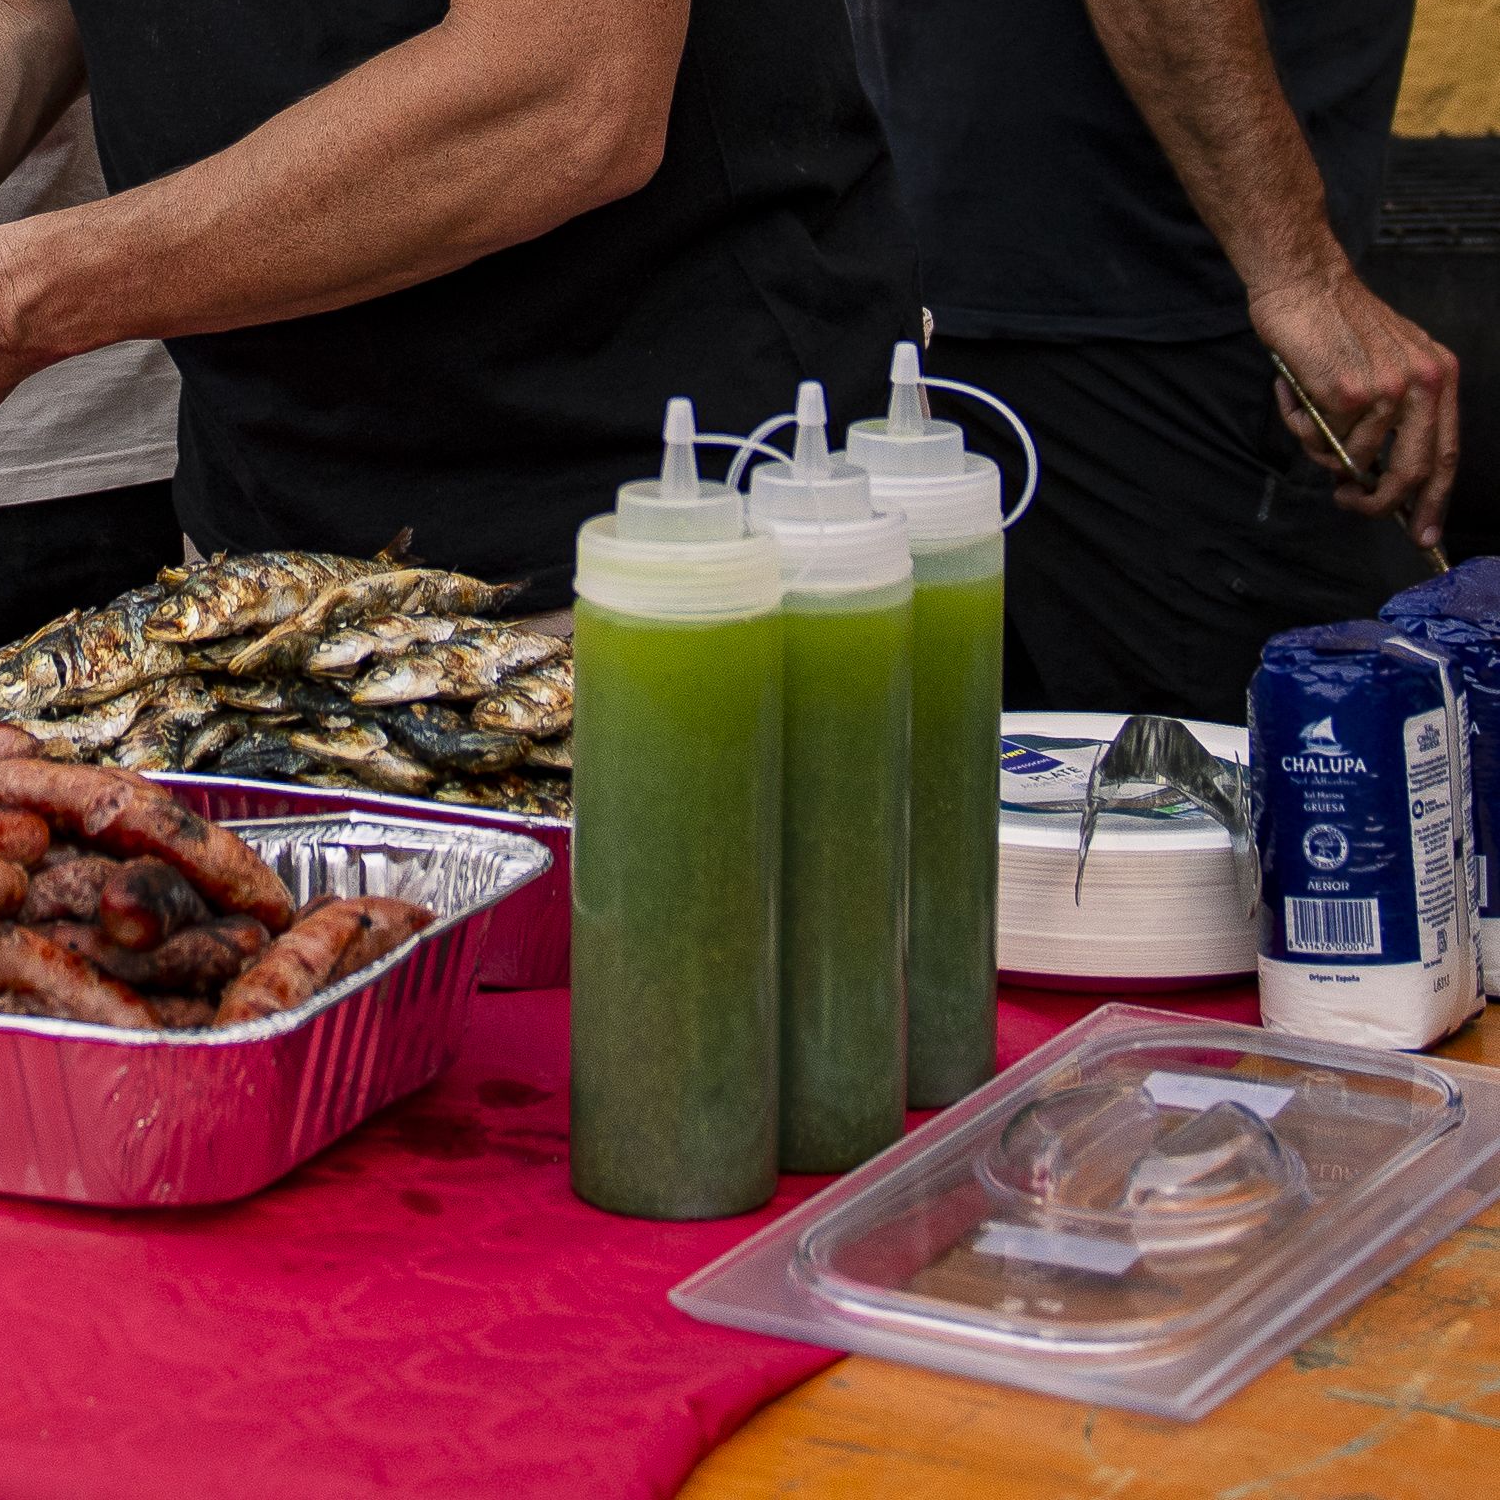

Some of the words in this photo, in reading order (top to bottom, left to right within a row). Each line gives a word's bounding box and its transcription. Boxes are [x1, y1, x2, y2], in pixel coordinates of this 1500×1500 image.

[1281, 756, 1368, 774] CHALUPA
[1027, 766, 1082, 781] PLATE
[1303, 803, 1346, 813] GRUESA
[1307, 881, 1350, 891] AENOR
